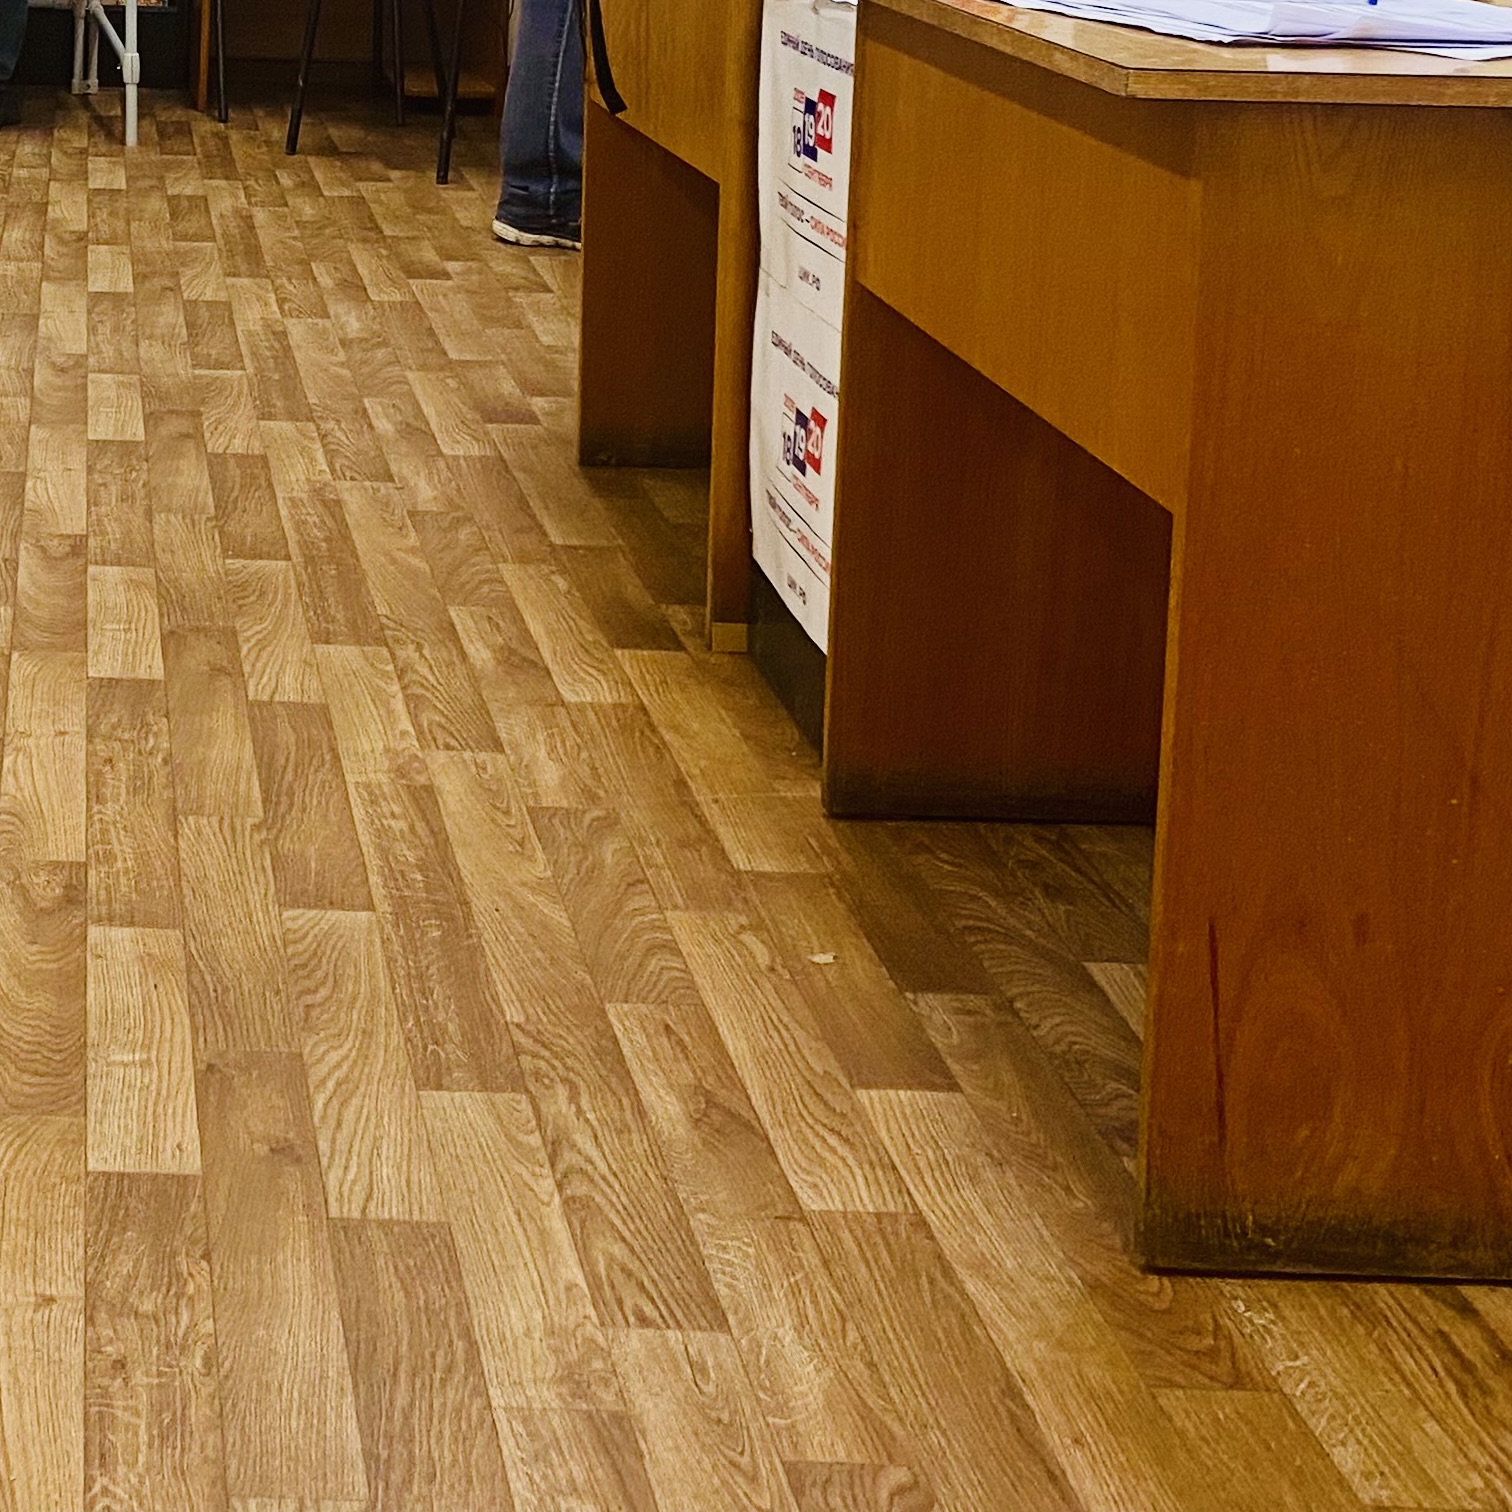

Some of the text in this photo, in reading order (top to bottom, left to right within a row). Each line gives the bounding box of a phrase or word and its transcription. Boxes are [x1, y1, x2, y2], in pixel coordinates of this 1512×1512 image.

[792, 101, 832, 159] 18 19 20
[795, 423, 807, 462] 19
[807, 419, 823, 461] 20
